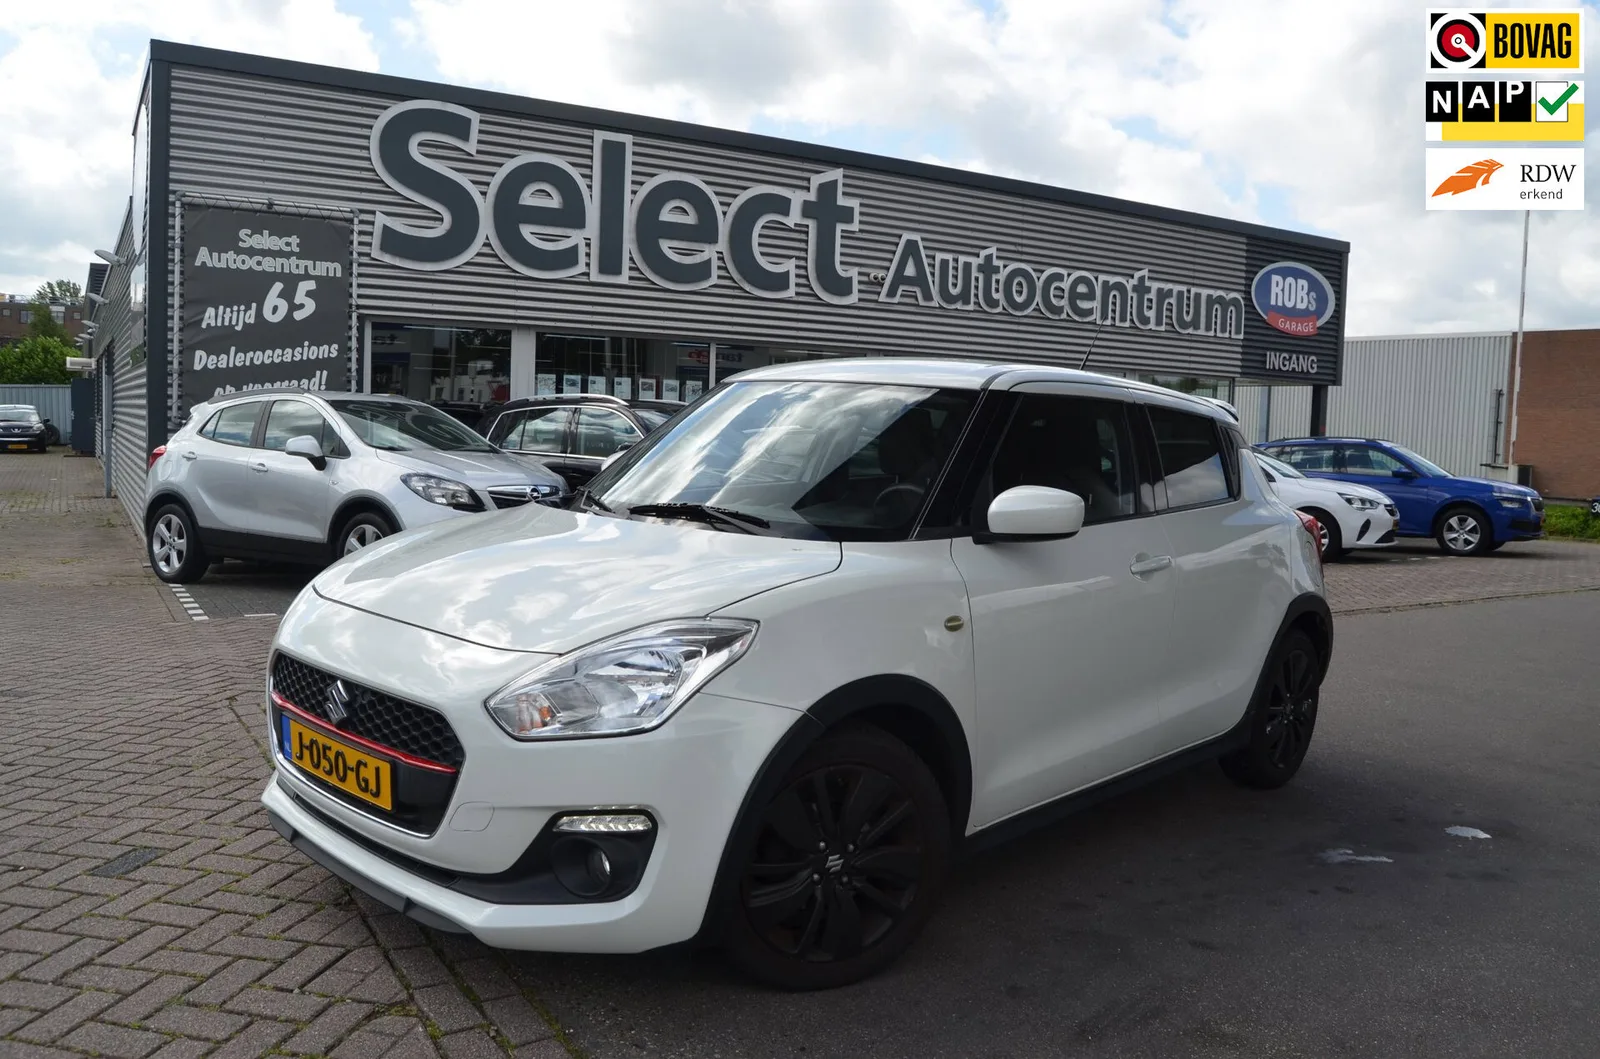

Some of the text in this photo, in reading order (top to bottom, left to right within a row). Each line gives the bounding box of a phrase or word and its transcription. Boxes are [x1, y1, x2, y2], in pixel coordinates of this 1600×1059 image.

[368, 99, 1245, 340] Select Autocentrum
[238, 228, 300, 253] Select
[194, 246, 342, 278] Autocentrum
[201, 280, 317, 331] Altijd 65
[1278, 318, 1314, 333] GARAGE
[193, 340, 339, 371] Dealeroccasions
[1266, 351, 1318, 374] INGANG
[295, 731, 382, 799] J-050-GJ
